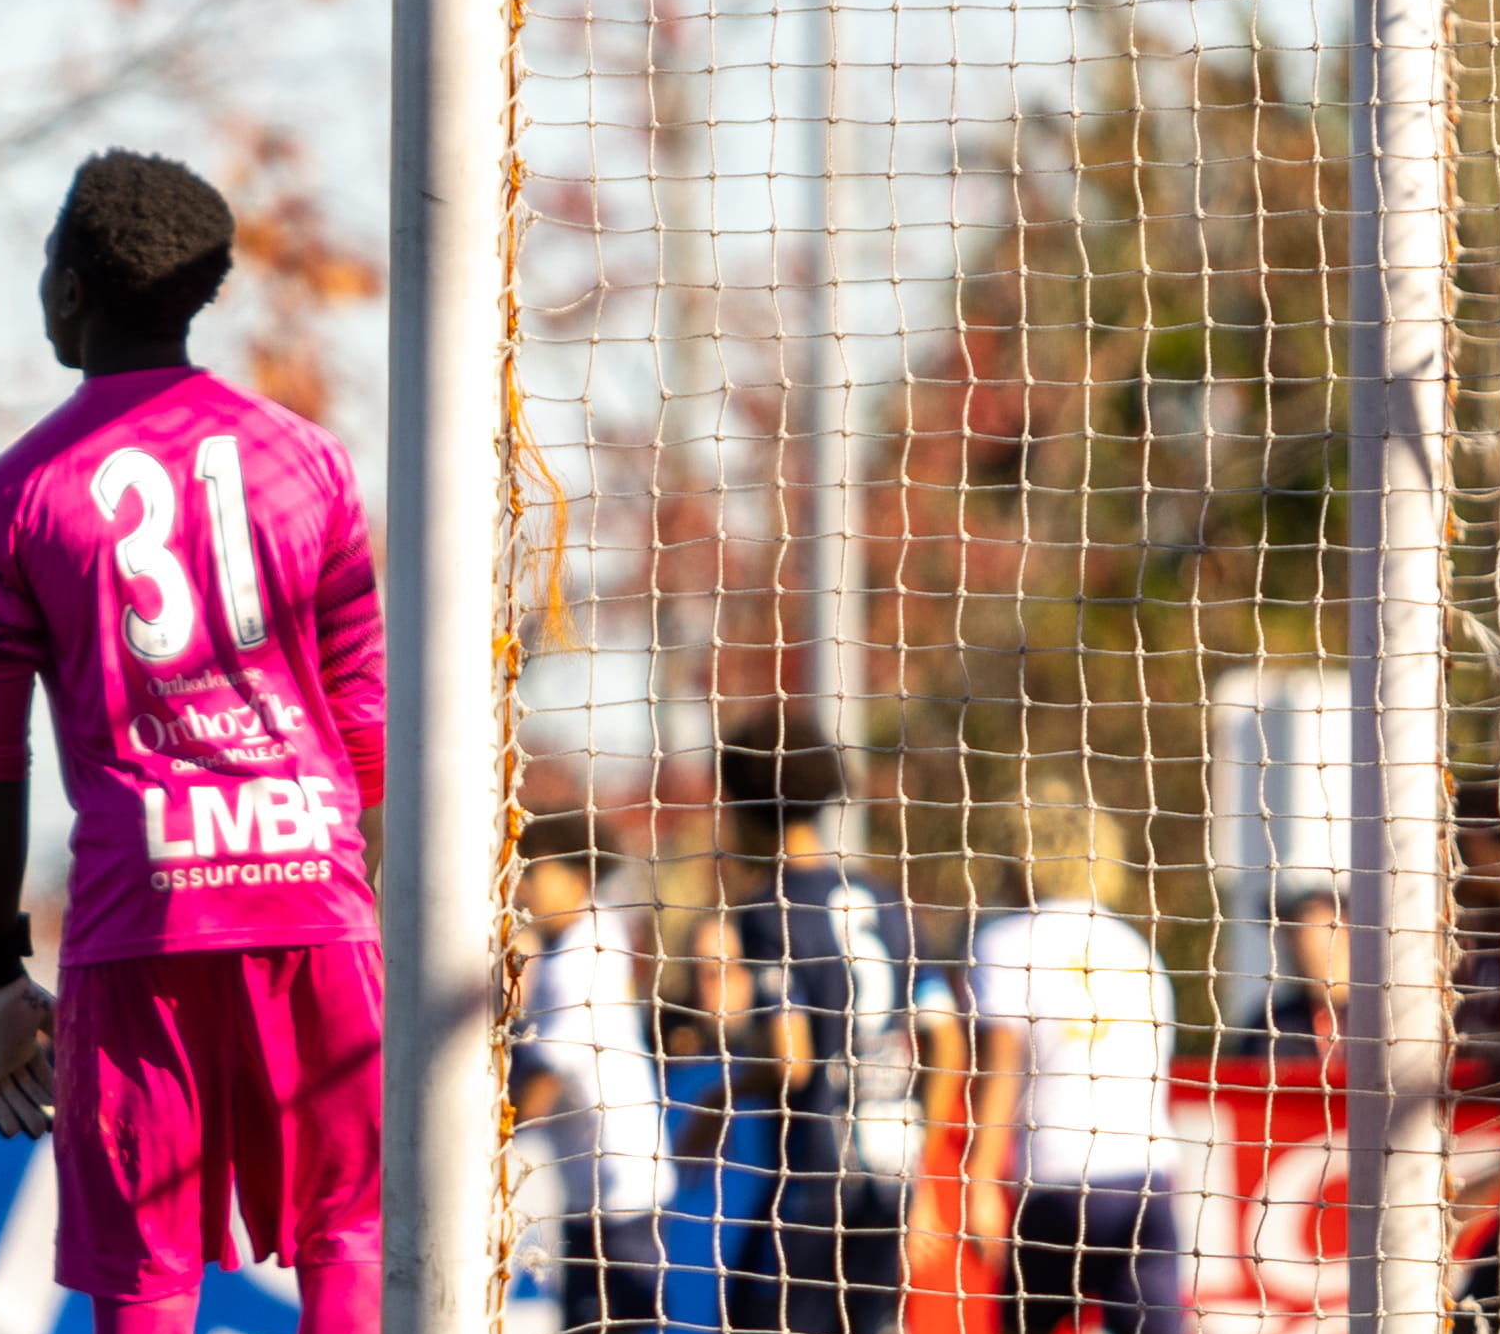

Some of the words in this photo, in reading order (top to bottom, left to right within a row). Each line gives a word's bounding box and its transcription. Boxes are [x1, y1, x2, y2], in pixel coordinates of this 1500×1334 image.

[91, 436, 268, 665] 31
[144, 777, 342, 861] LMBF
[150, 859, 333, 892] assurances
